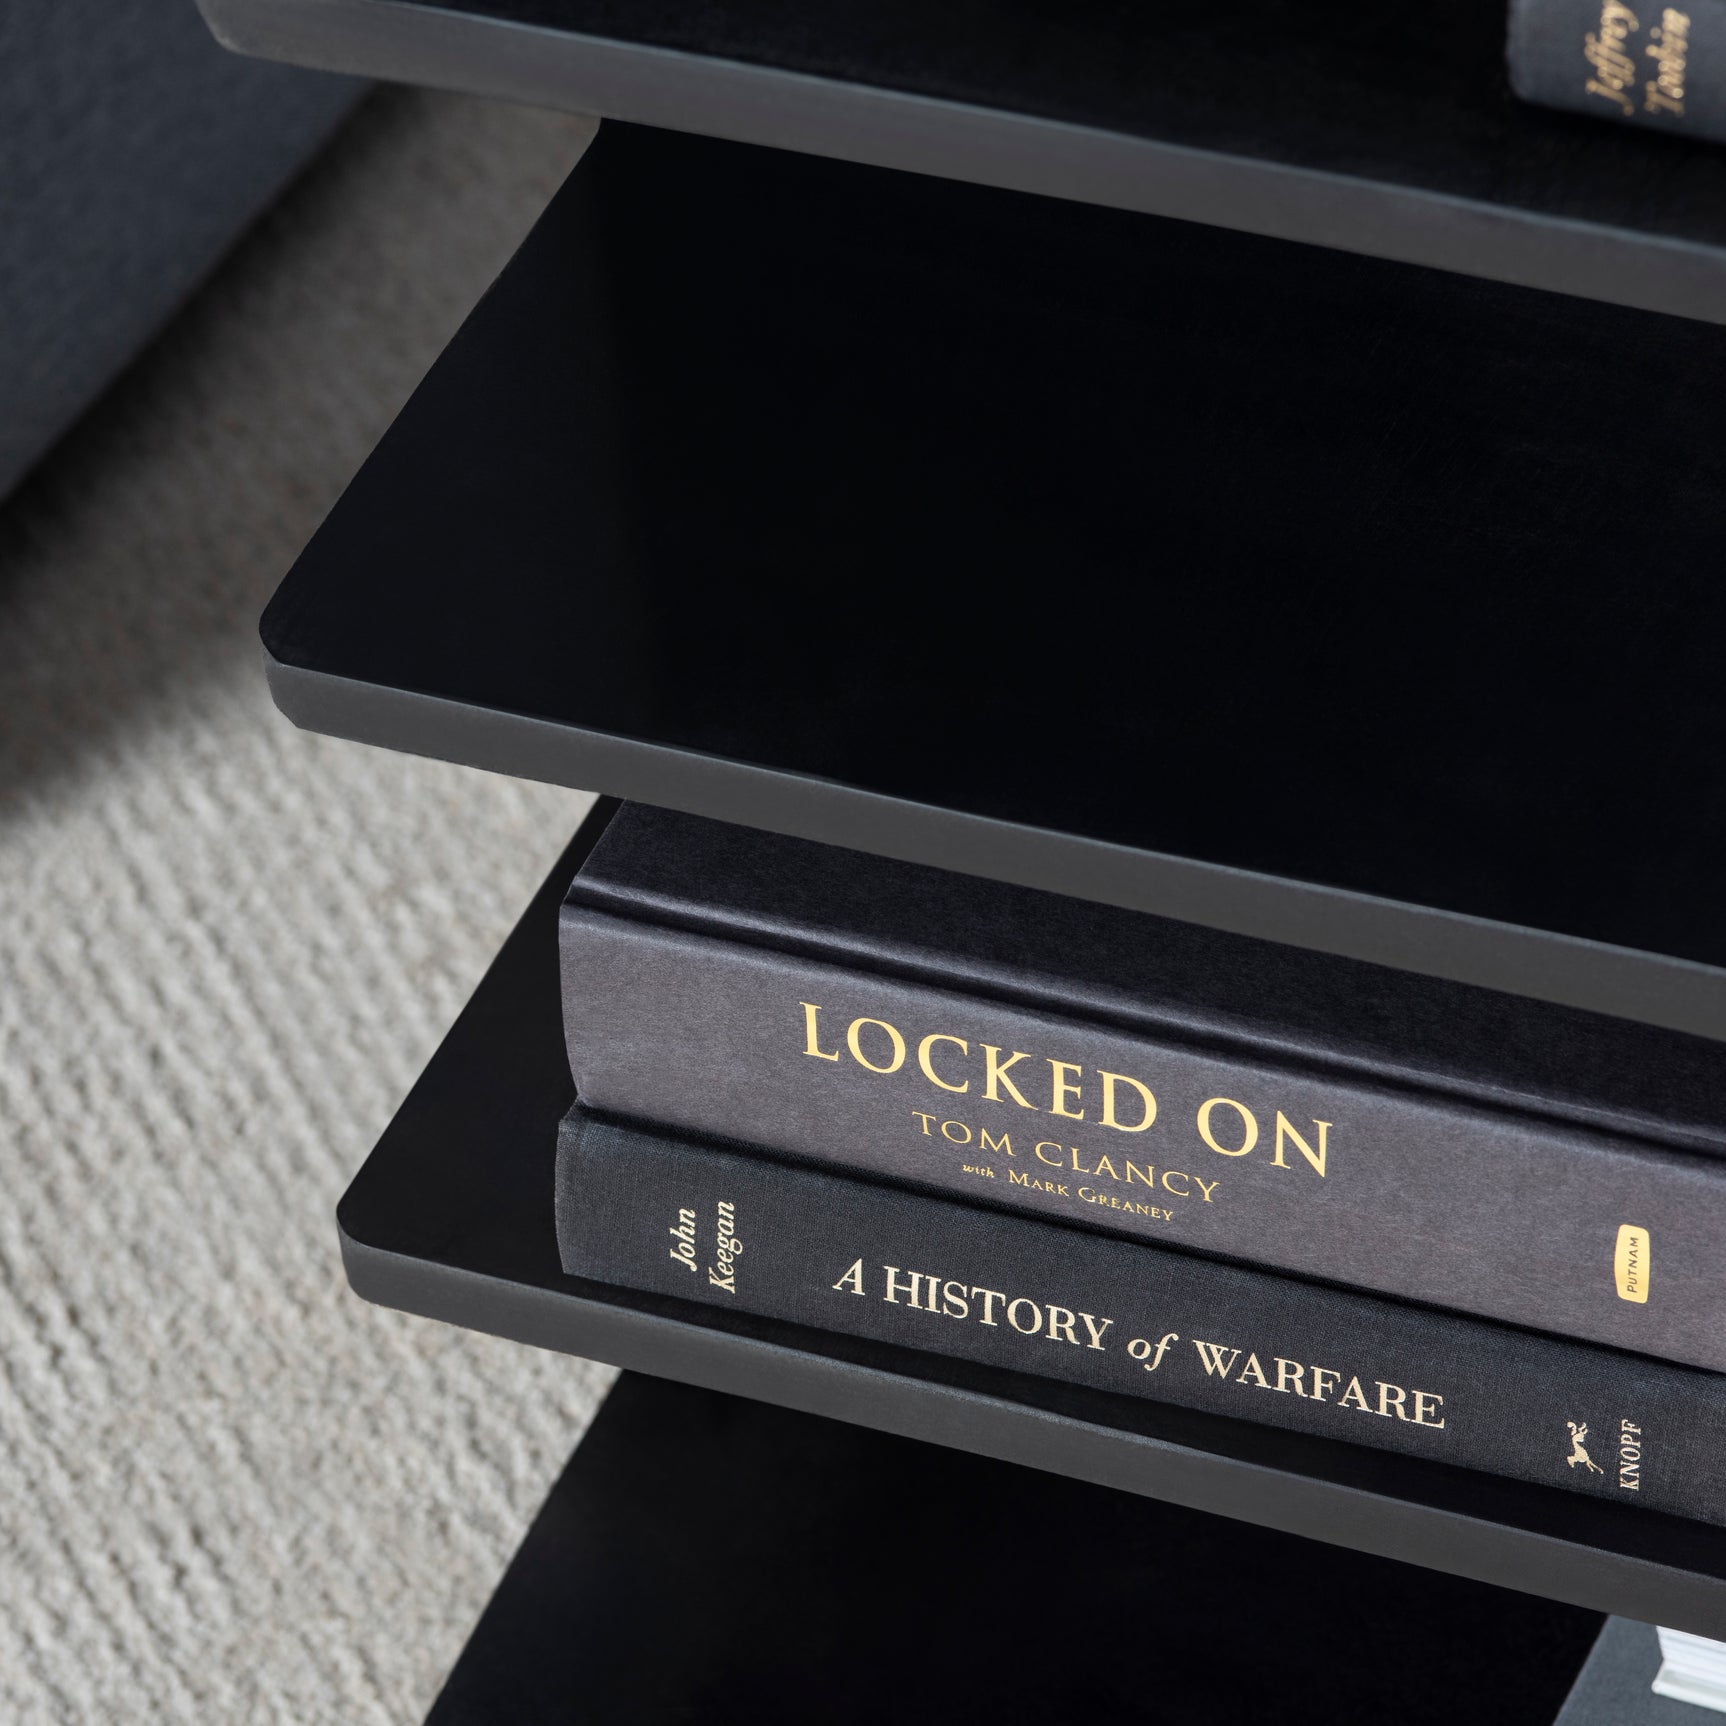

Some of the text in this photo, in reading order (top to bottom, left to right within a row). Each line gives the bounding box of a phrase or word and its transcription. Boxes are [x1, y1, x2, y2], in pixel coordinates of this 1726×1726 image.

[1584, 0, 1639, 116] Jeffrey
[1645, 8, 1690, 117] Toobin
[799, 1001, 1333, 1178] LOCKED ON
[911, 1111, 1222, 1203] TOM CLANCY
[962, 1163, 1174, 1221] with MARK GREANEY
[669, 1207, 697, 1272] John
[707, 1200, 743, 1294] Keegan
[1626, 1236, 1640, 1293] PUTNAM
[832, 1258, 1446, 1430] A HISTORY of WARFARE
[1619, 1418, 1642, 1492] KNOPF
